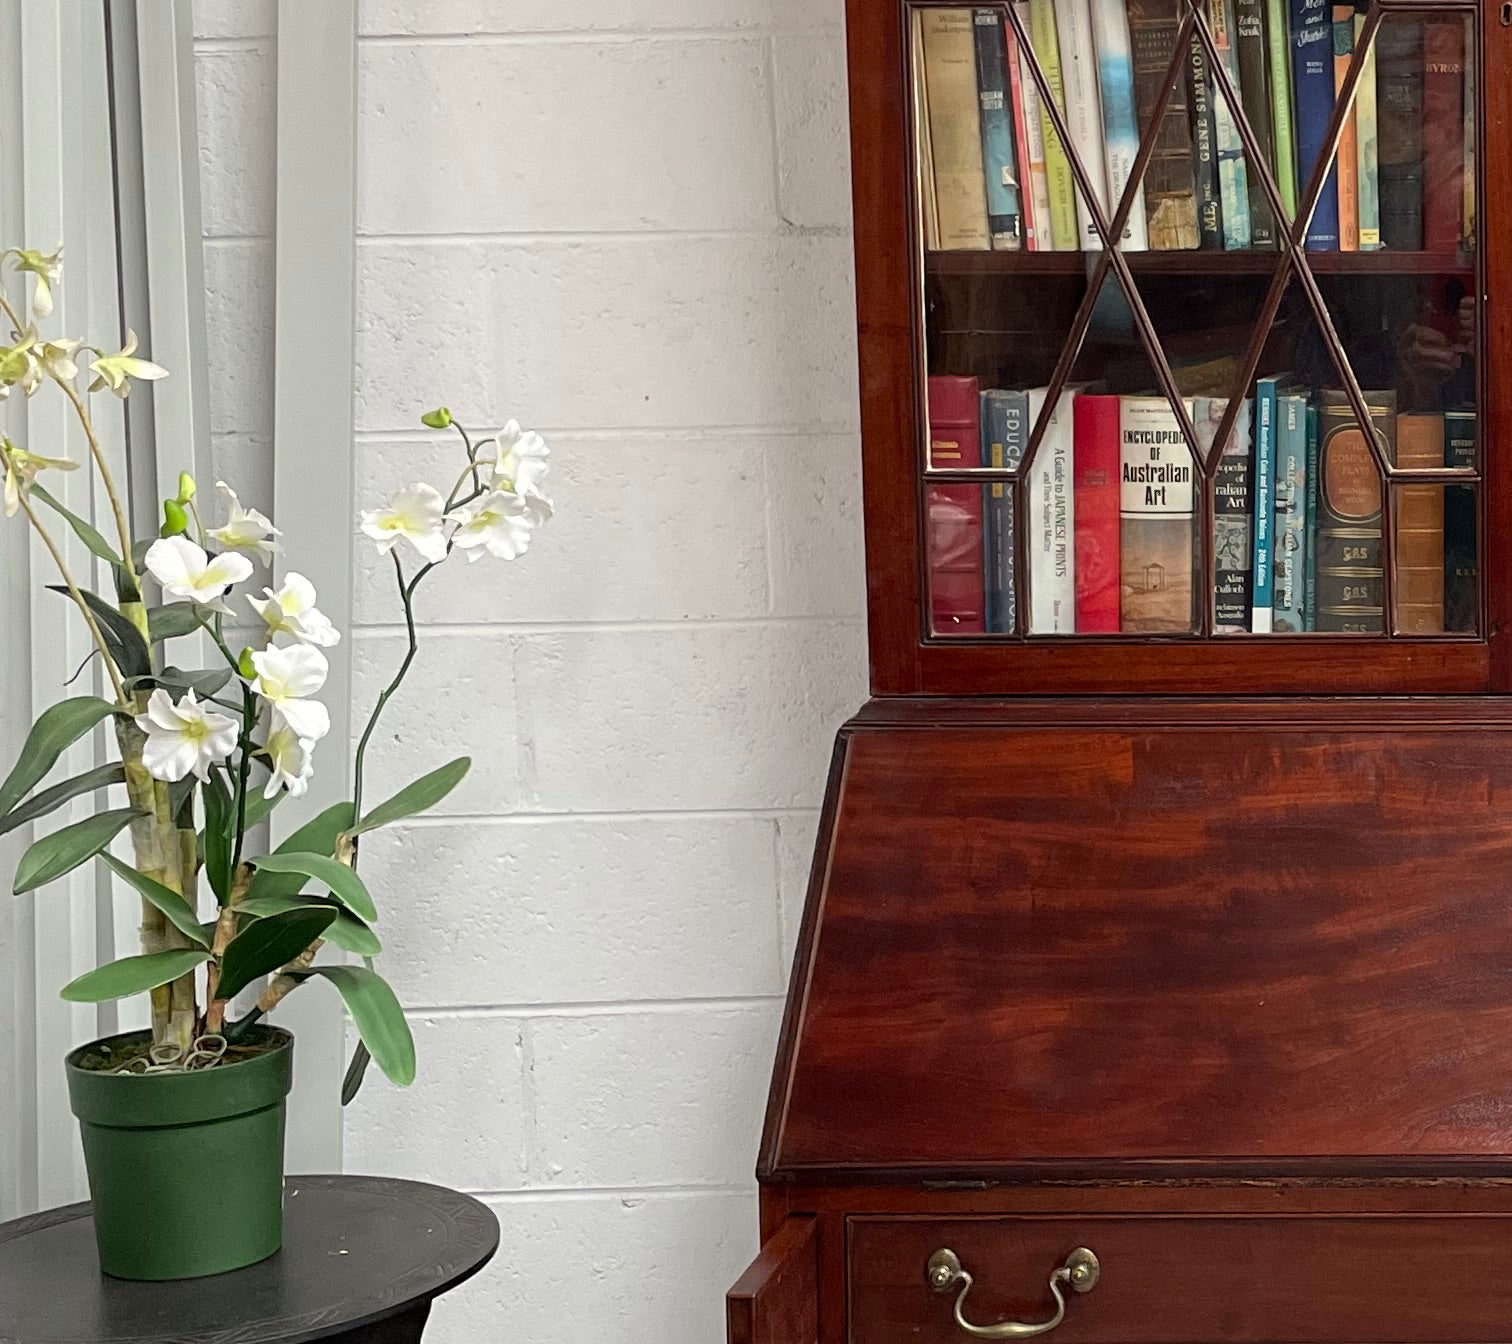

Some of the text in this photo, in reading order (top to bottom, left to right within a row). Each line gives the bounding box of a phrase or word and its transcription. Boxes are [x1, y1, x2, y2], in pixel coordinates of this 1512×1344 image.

[938, 14, 970, 24] William
[1304, 12, 1324, 25] and
[1190, 32, 1207, 113] SIMMONS
[1425, 62, 1461, 74] BYRON
[1197, 117, 1211, 163] GENE
[1056, 167, 1069, 205] DOVER
[1287, 403, 1296, 431] JAMES
[1261, 426, 1269, 459] Australian
[1149, 446, 1161, 461] OF
[1043, 471, 1052, 484] and
[1054, 457, 1065, 483] Guide
[1122, 461, 1190, 484] Australian
[1260, 459, 1268, 475] Coin
[1055, 483, 1063, 494] to
[1234, 473, 1245, 483] of
[1260, 475, 1268, 487] and
[1144, 485, 1167, 506] Art
[1215, 482, 1248, 496] ralian
[1226, 496, 1246, 508] Art
[1259, 488, 1268, 518] Banknote
[1054, 494, 1066, 541] JAPANESE
[1259, 519, 1267, 540] Values
[1283, 455, 1295, 608] COLLECTING AUSTRALIAN GEMSTONES
[1043, 529, 1053, 553] Matter
[1055, 543, 1067, 578] PRINTS
[1224, 573, 1245, 584] Alan
[1257, 564, 1266, 587] Edition
